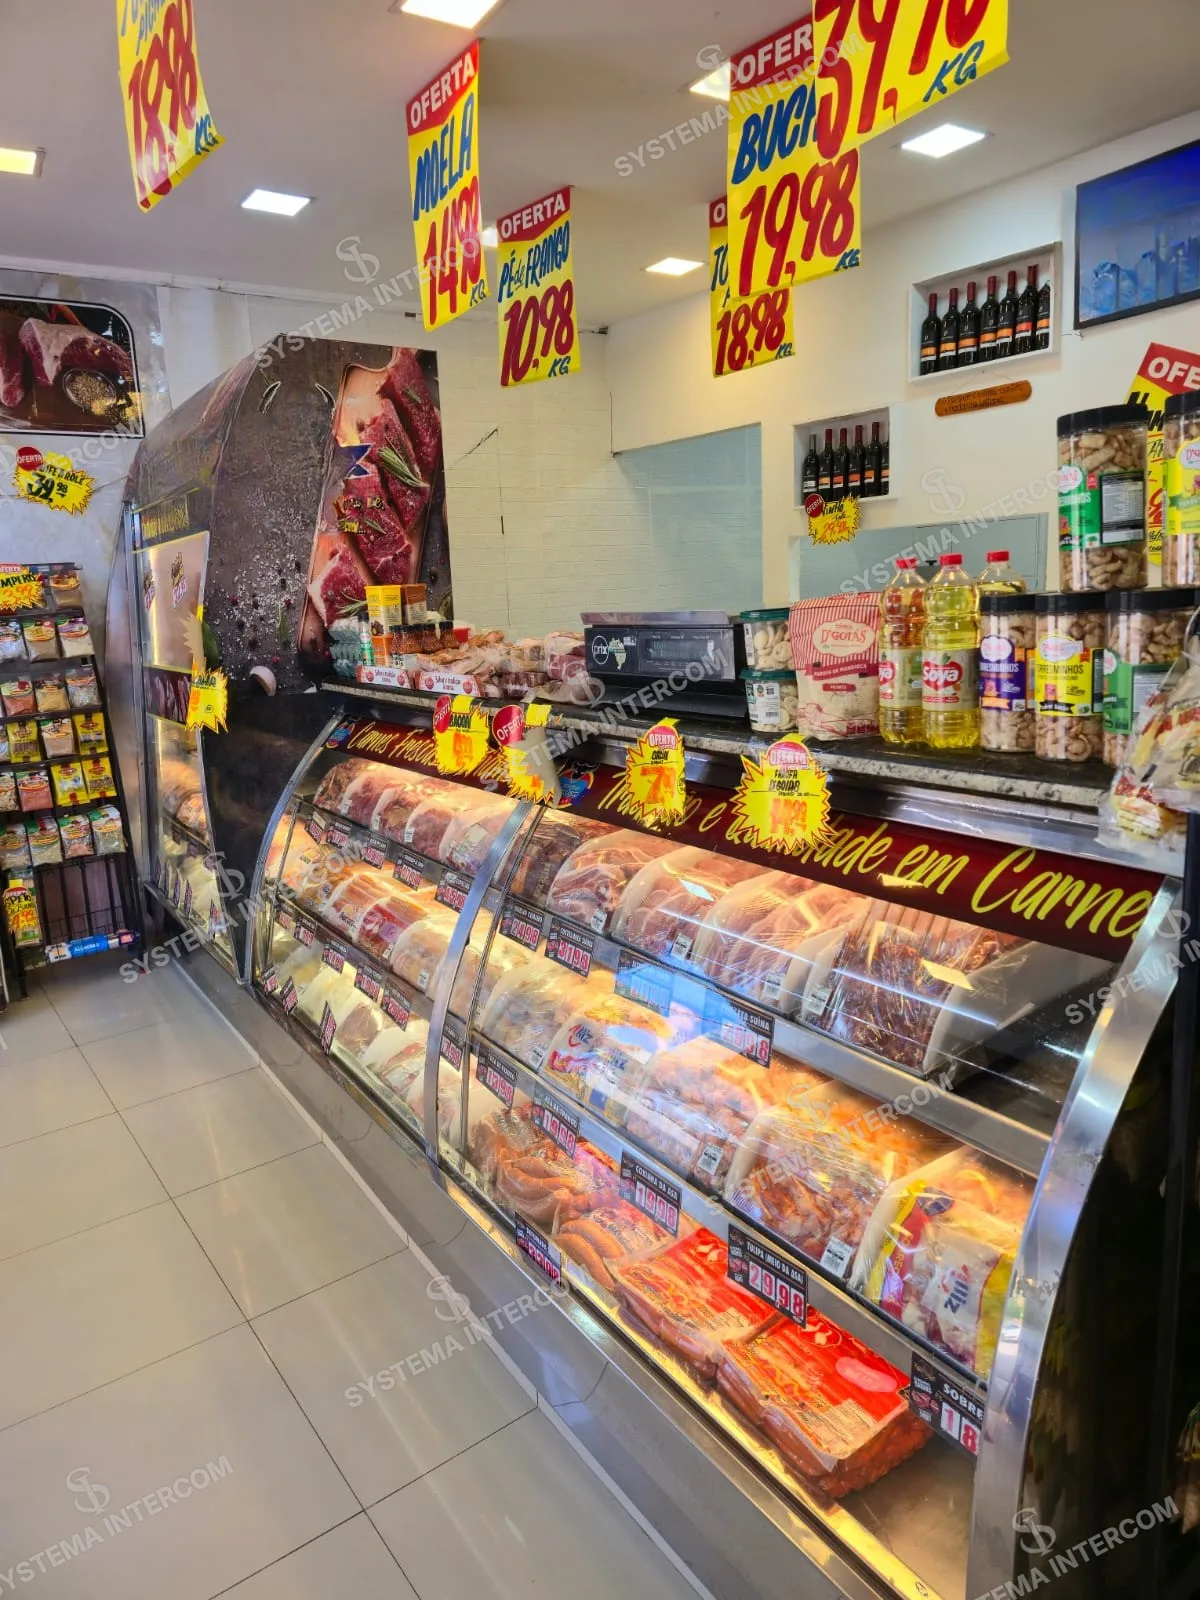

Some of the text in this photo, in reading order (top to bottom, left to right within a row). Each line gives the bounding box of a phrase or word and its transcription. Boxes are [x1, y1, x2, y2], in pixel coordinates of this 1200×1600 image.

[735, 22, 813, 84] OFER
[923, 40, 985, 102] KG
[410, 51, 475, 129] OFERTA
[194, 113, 218, 156] KG
[413, 92, 475, 221] MOELA
[501, 193, 565, 239] OFERTA
[739, 148, 859, 297] 19,98
[497, 250, 515, 303] PÉ
[525, 219, 571, 290] FRANGO
[834, 248, 860, 271] KG
[470, 277, 487, 307] KG
[501, 279, 575, 387] 10,98
[715, 289, 790, 376] 18,98
[775, 343, 793, 358] KG
[548, 356, 572, 378] KG
[1147, 356, 1200, 390] OFE
[16, 454, 43, 464] OFERTA
[0, 572, 36, 588] MPERO
[698, 803, 728, 832] e
[893, 844, 969, 894] em
[970, 847, 1155, 938] Carne
[943, 1383, 984, 1420] SOBRE
